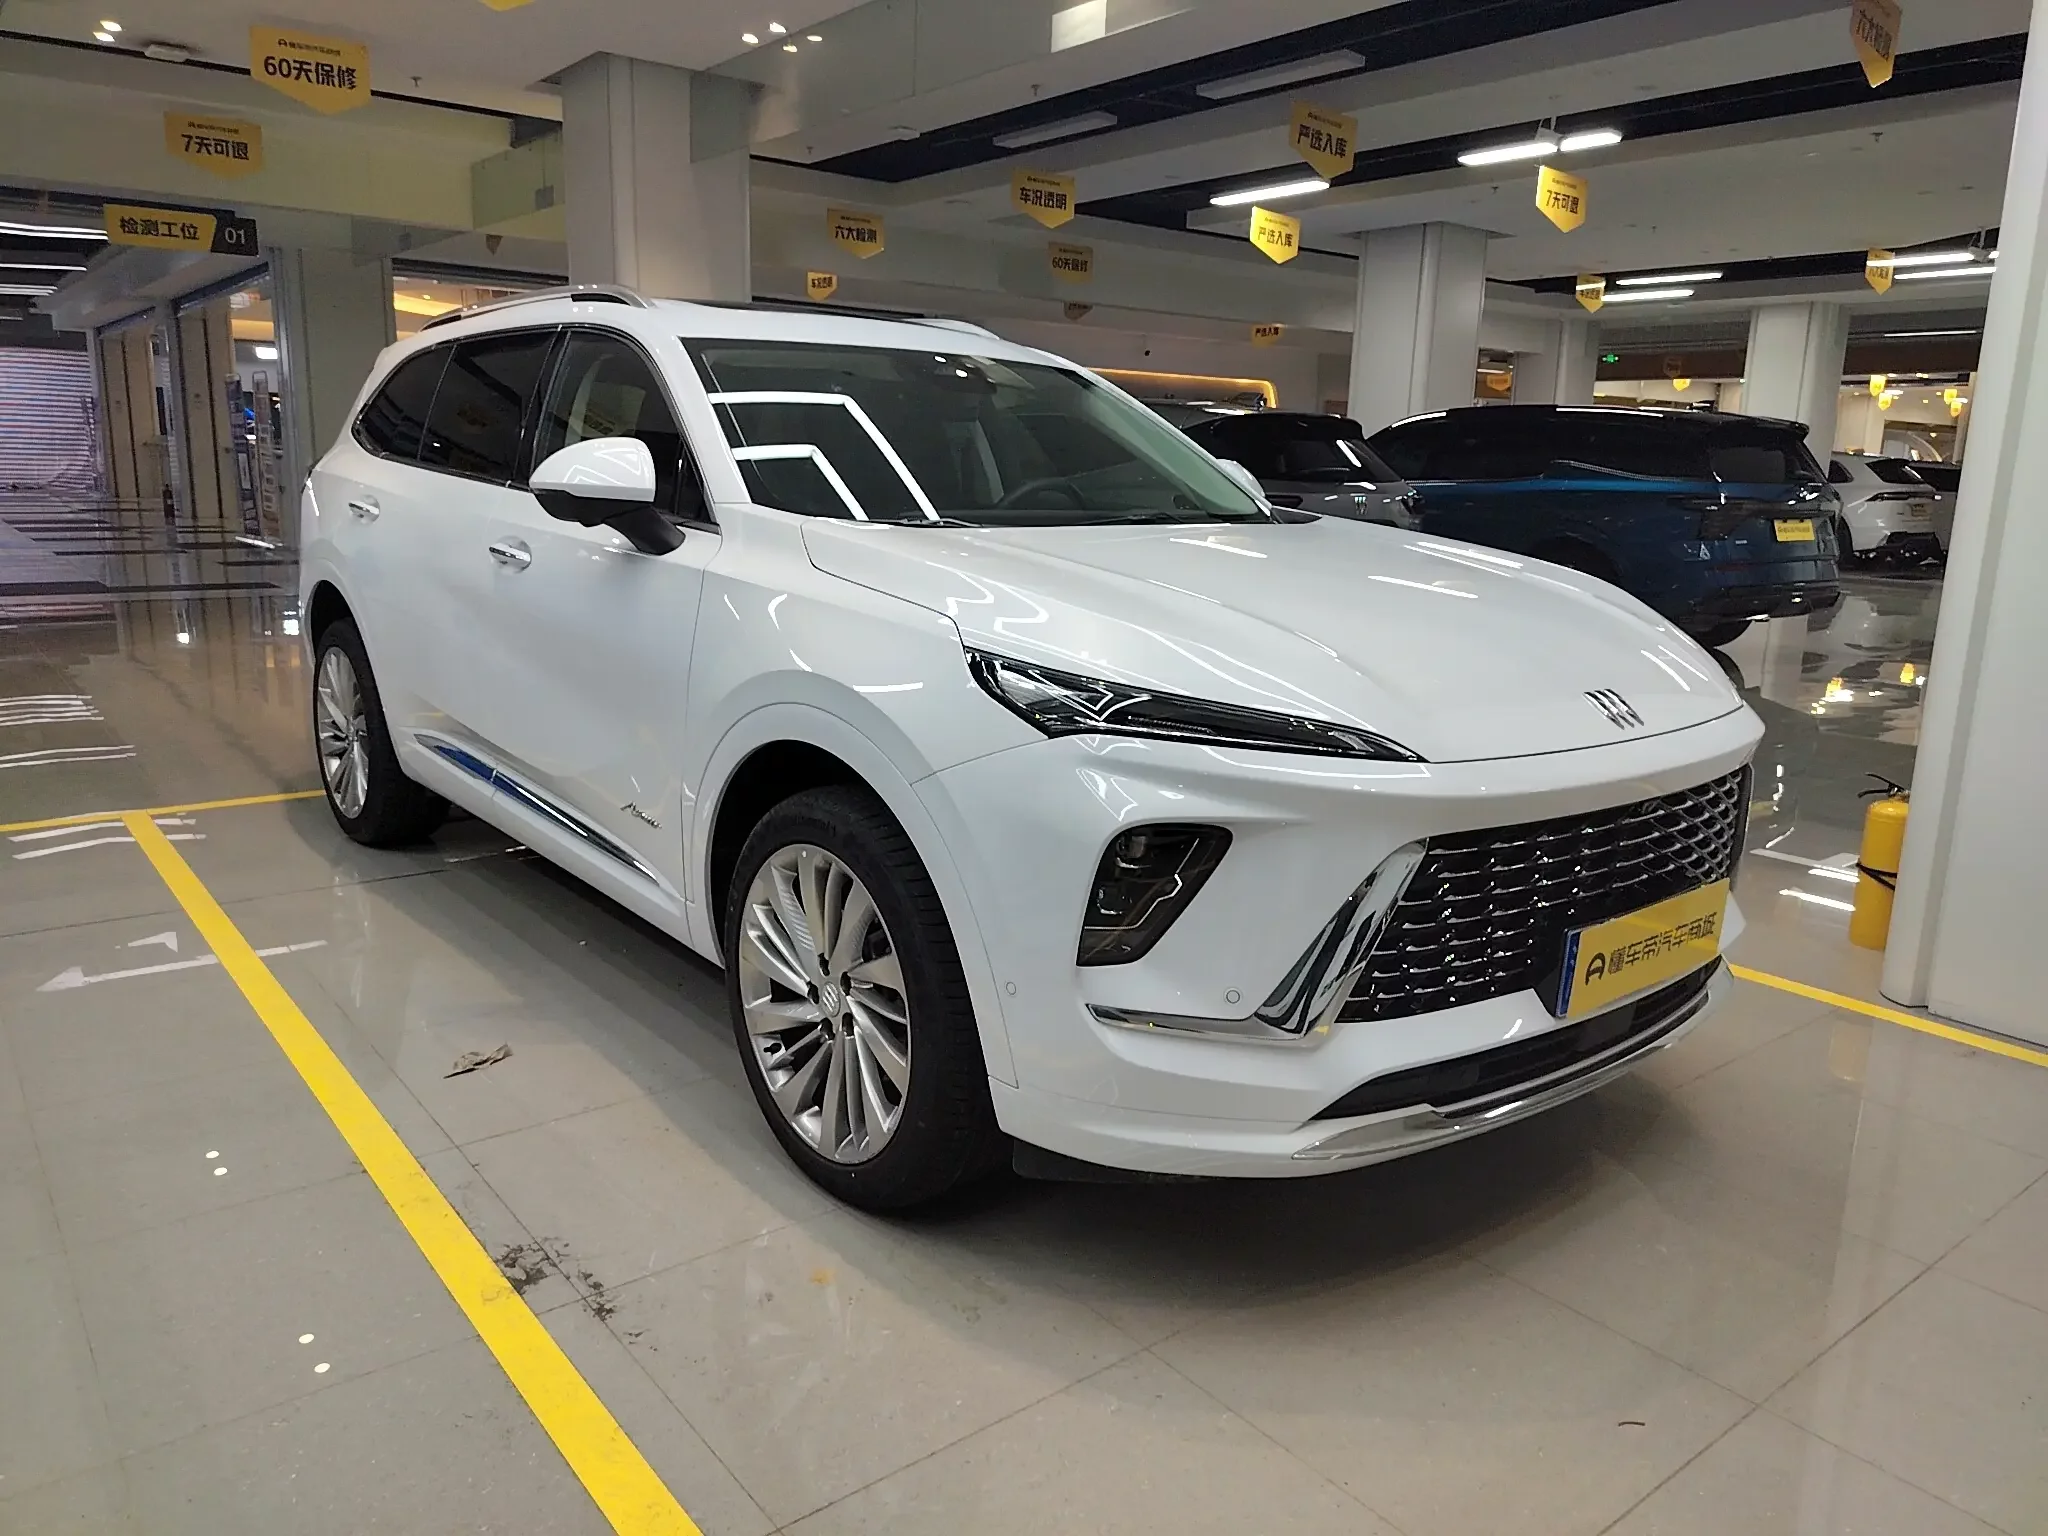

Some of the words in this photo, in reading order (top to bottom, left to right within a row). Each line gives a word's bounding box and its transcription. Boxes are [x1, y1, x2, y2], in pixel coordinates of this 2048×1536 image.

[263, 56, 357, 89] 60天保修
[181, 133, 249, 161] 7天可退
[1297, 124, 1348, 158] 严选入库
[1019, 186, 1068, 211] 车况透明
[1545, 189, 1580, 215] 7天可退
[119, 215, 200, 241] 检测工位
[224, 227, 246, 245] 01
[1257, 226, 1294, 248] 严选入库
[1607, 911, 1718, 975] 懂车帝汽车商城
